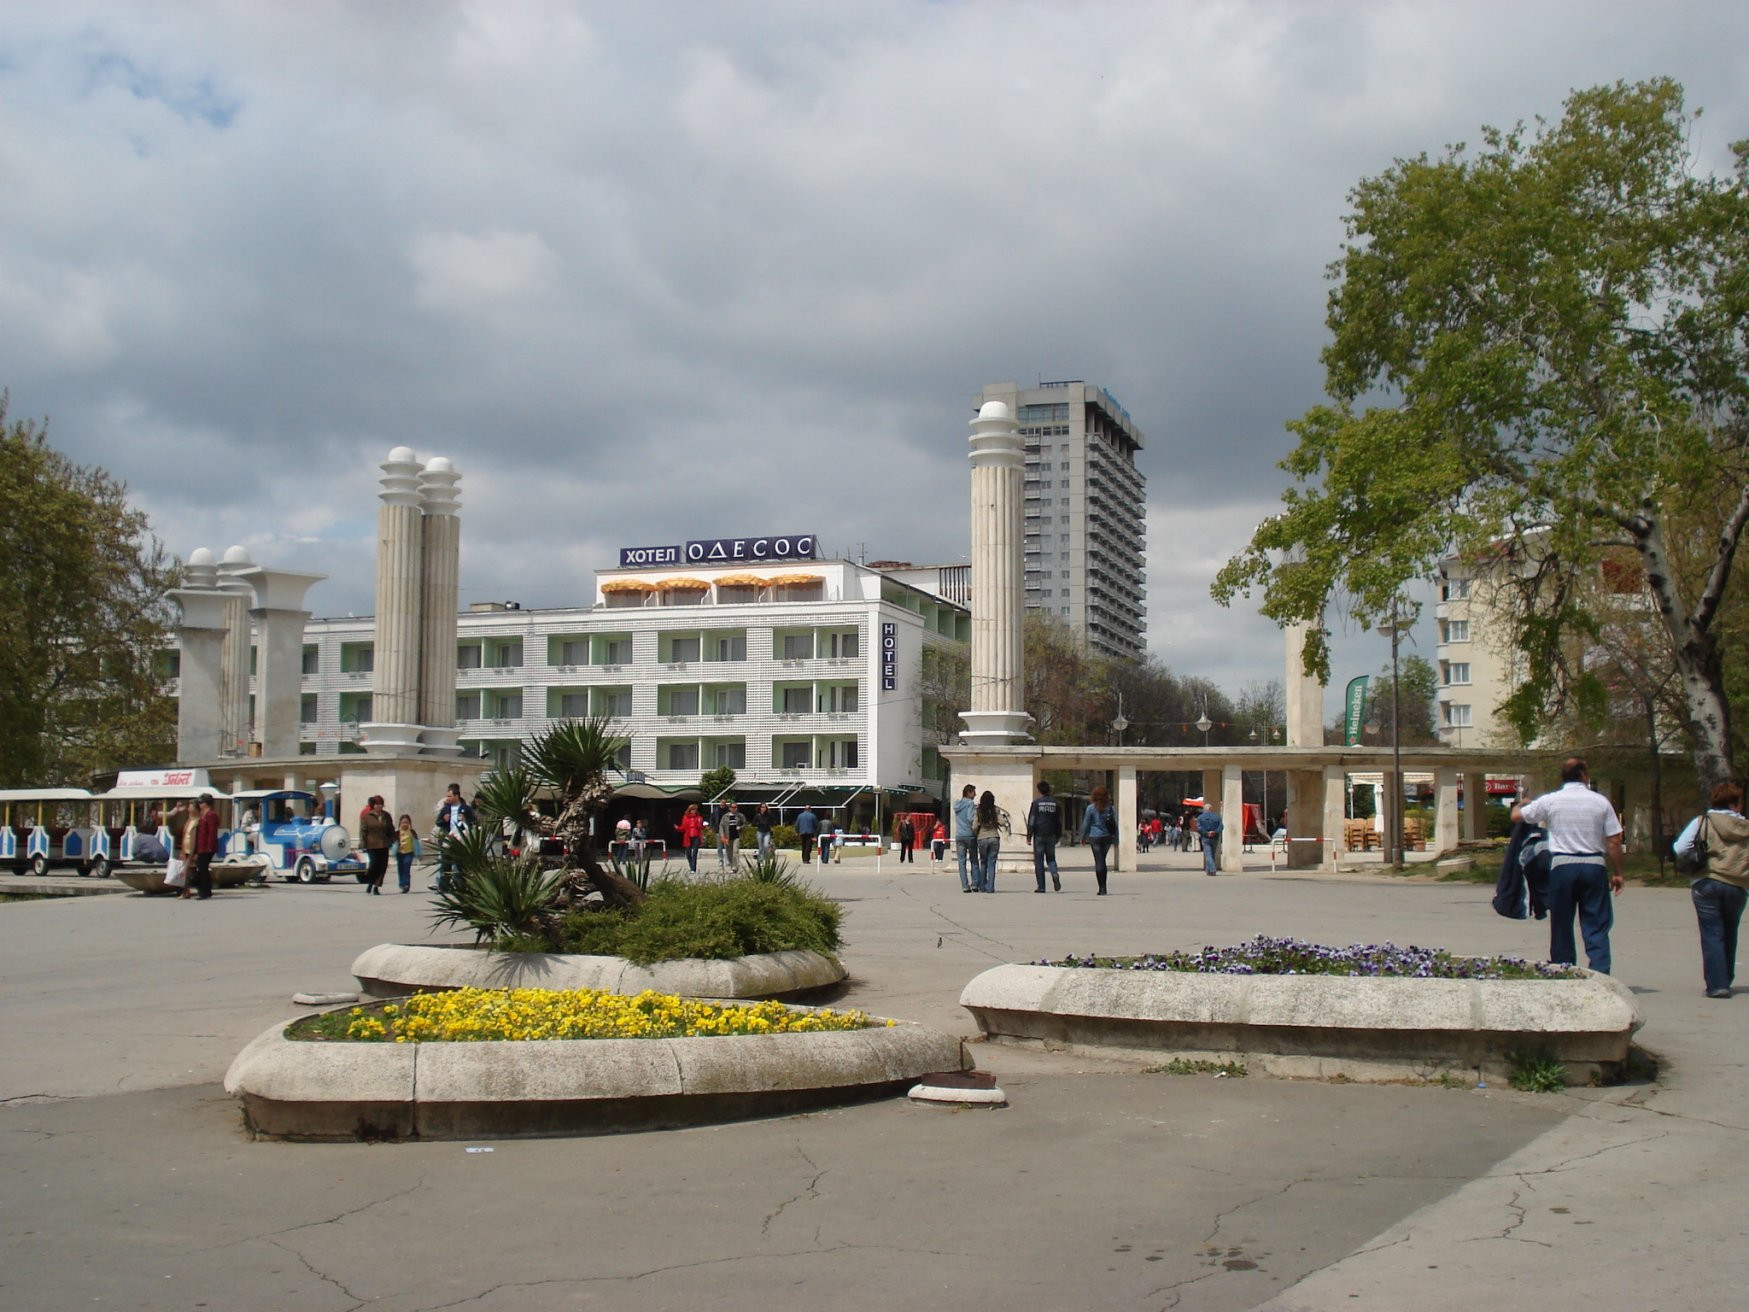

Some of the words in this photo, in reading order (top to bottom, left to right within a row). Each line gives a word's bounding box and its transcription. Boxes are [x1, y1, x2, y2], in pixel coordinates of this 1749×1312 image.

[625, 548, 675, 563] ХОТЕЛ
[884, 624, 894, 689] HOTEL
[1349, 685, 1363, 734] Heineken
